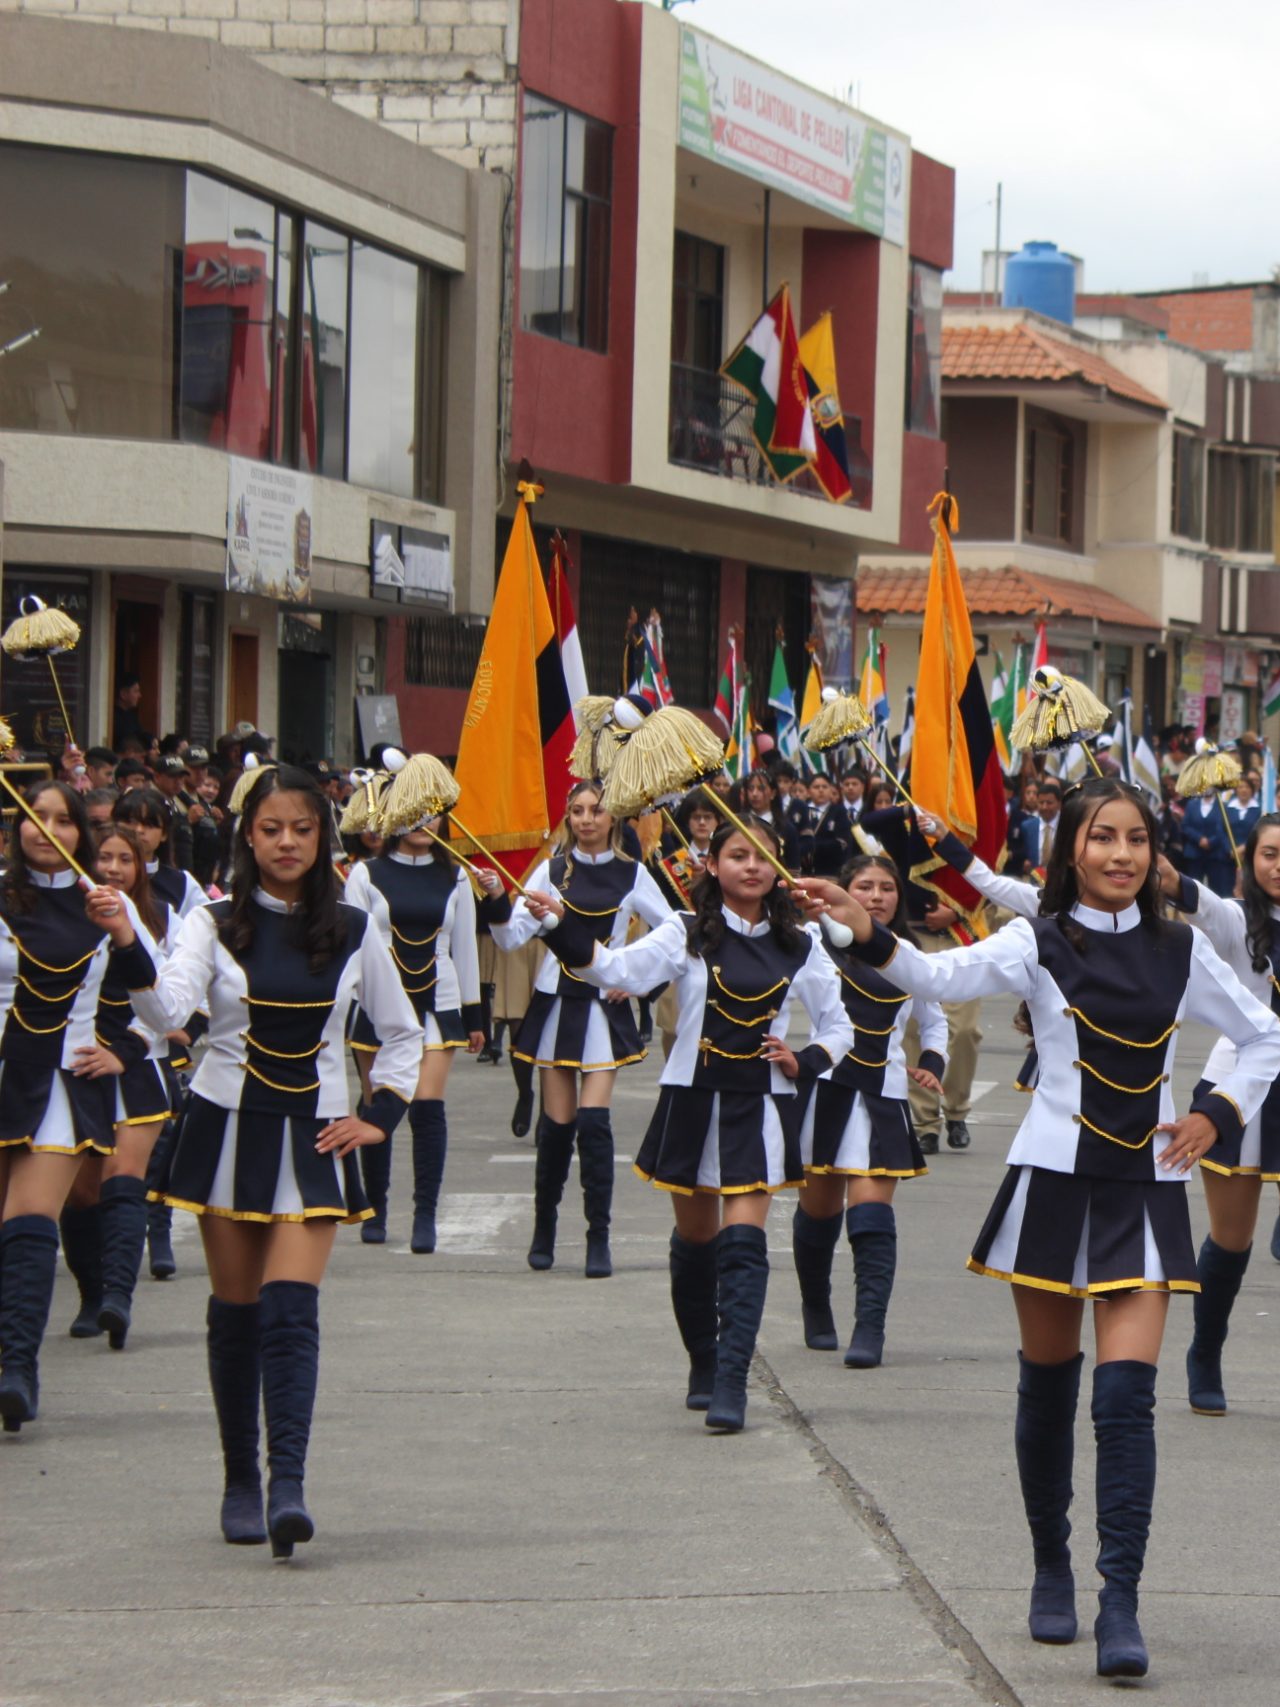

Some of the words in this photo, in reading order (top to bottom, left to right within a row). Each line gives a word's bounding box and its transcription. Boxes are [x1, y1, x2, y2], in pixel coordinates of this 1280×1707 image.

[733, 76, 752, 110] LIGA
[755, 87, 797, 136] CANTONAL
[801, 109, 811, 142] DE
[234, 539, 250, 552] KAPPA
[464, 660, 493, 729] EDUCATIVA
